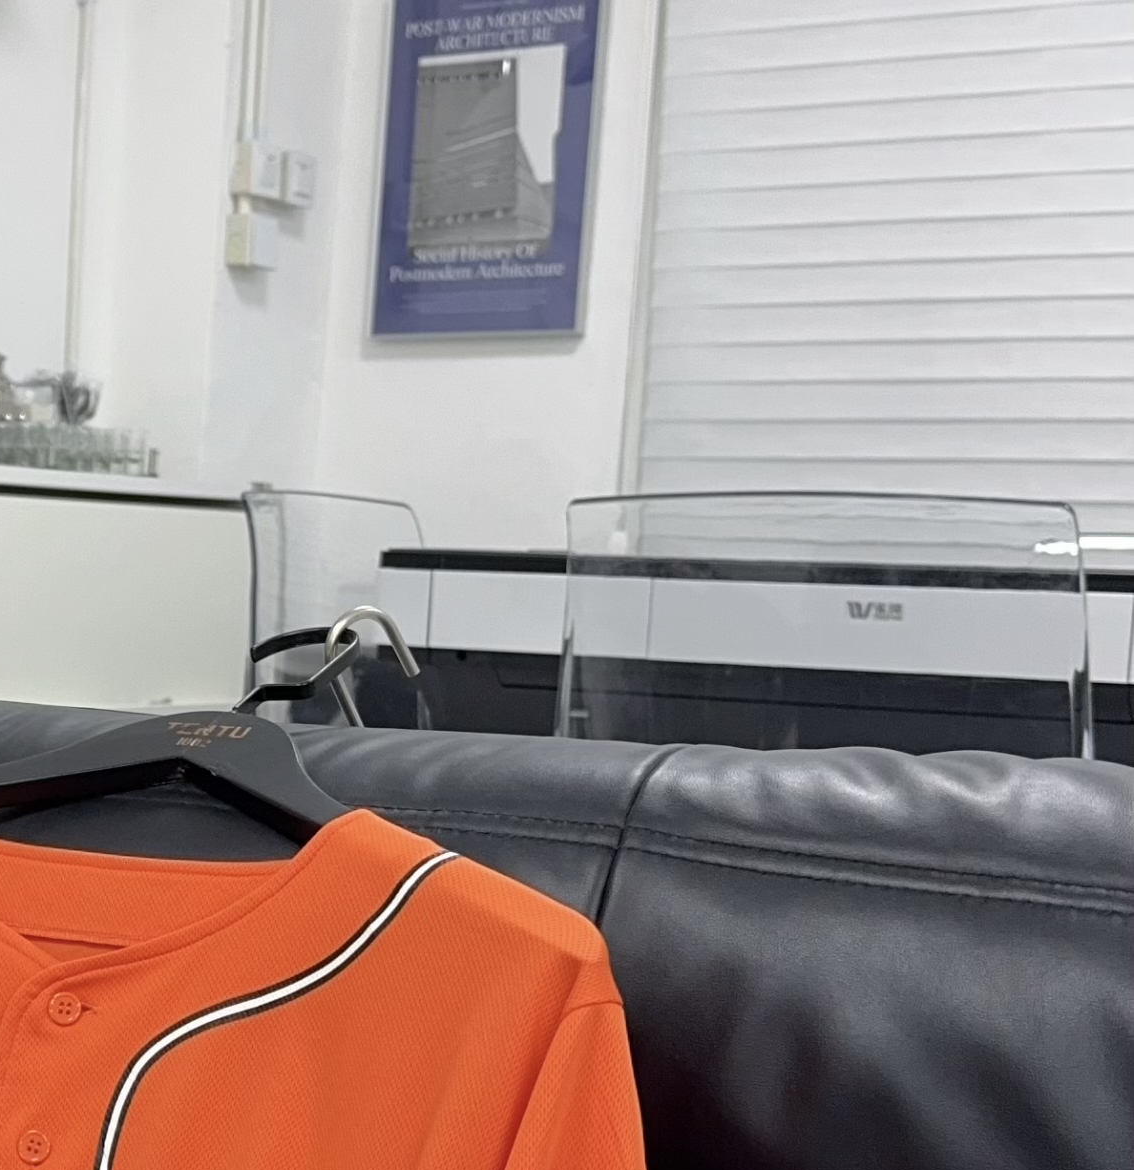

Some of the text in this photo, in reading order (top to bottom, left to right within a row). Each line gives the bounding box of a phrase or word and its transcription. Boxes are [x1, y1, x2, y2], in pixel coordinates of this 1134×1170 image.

[486, 4, 585, 31] MODERNISM
[436, 26, 553, 51] ARCHITECTURE
[477, 260, 564, 279] Architecture
